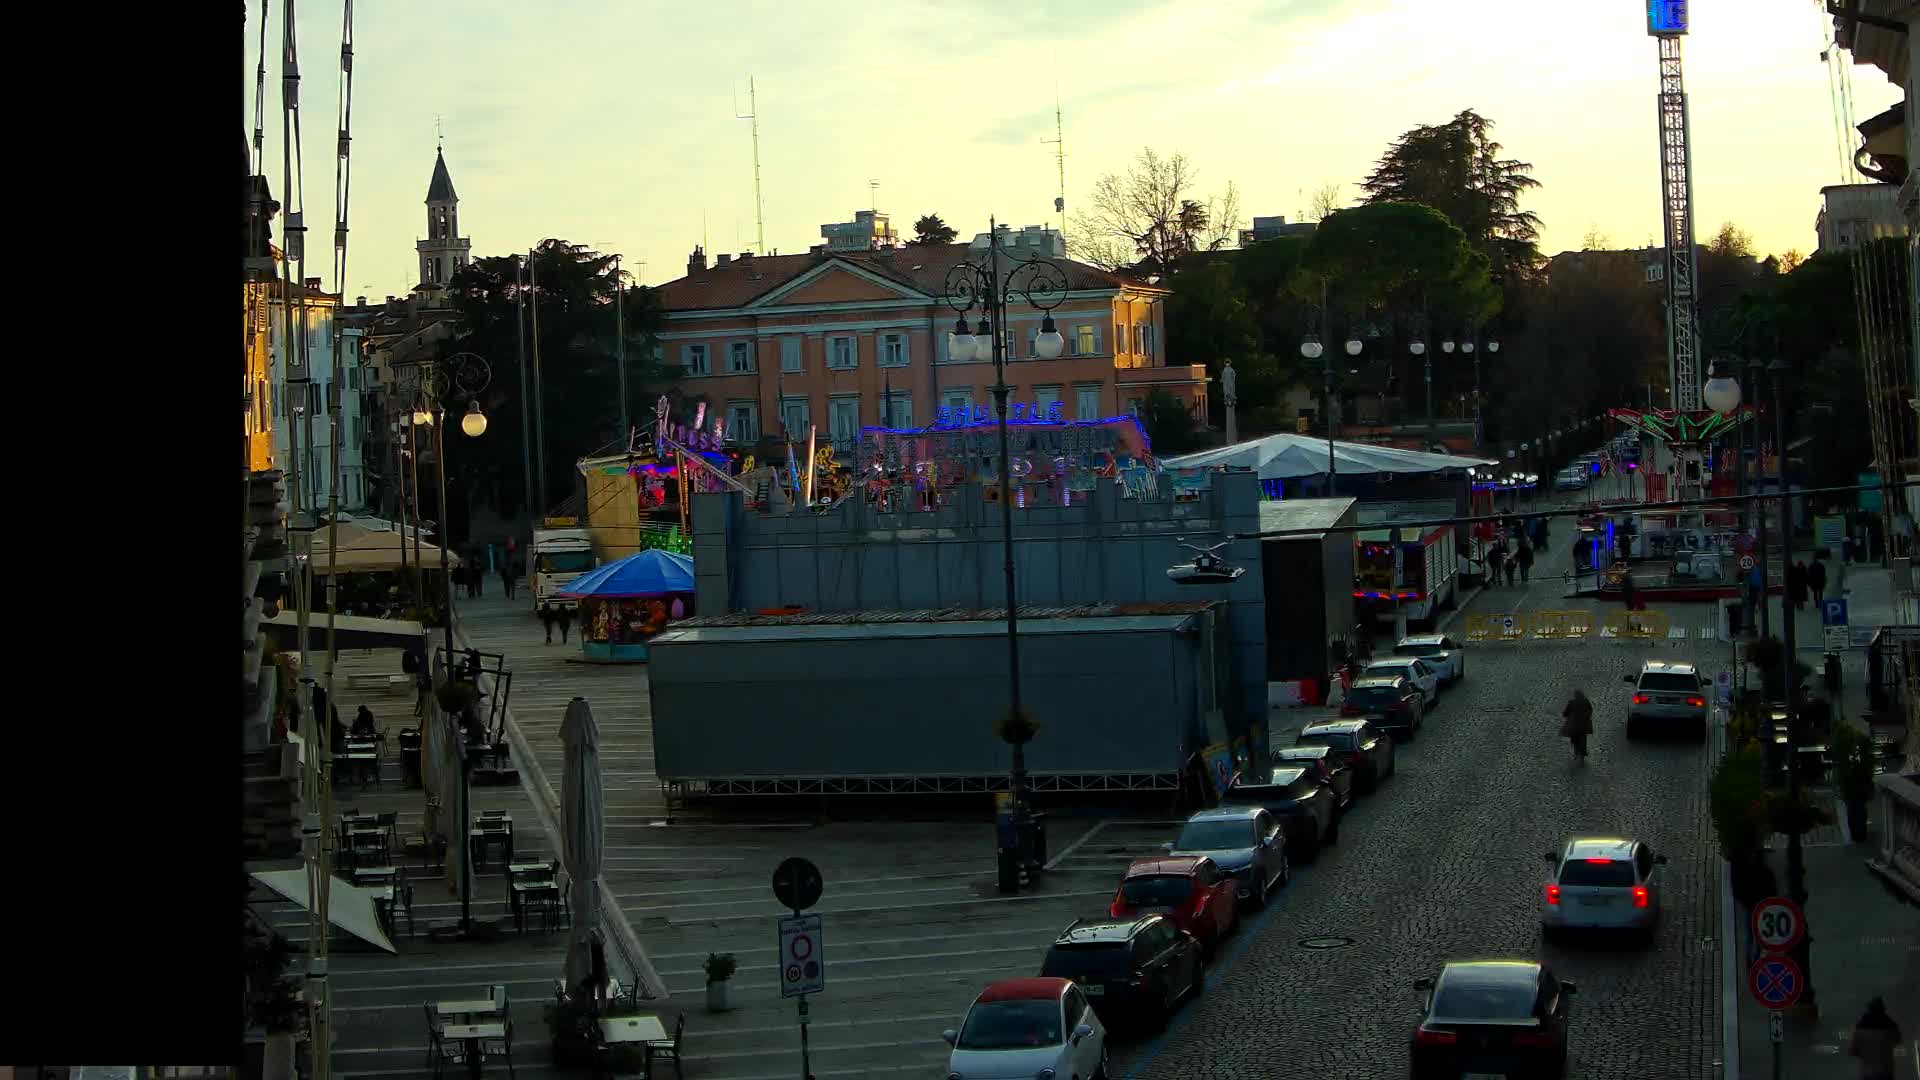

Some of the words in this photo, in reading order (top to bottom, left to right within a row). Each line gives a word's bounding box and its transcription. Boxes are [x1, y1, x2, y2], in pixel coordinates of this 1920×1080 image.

[1742, 558, 1752, 567] 20
[1827, 602, 1841, 624] P
[1762, 912, 1790, 938] 30
